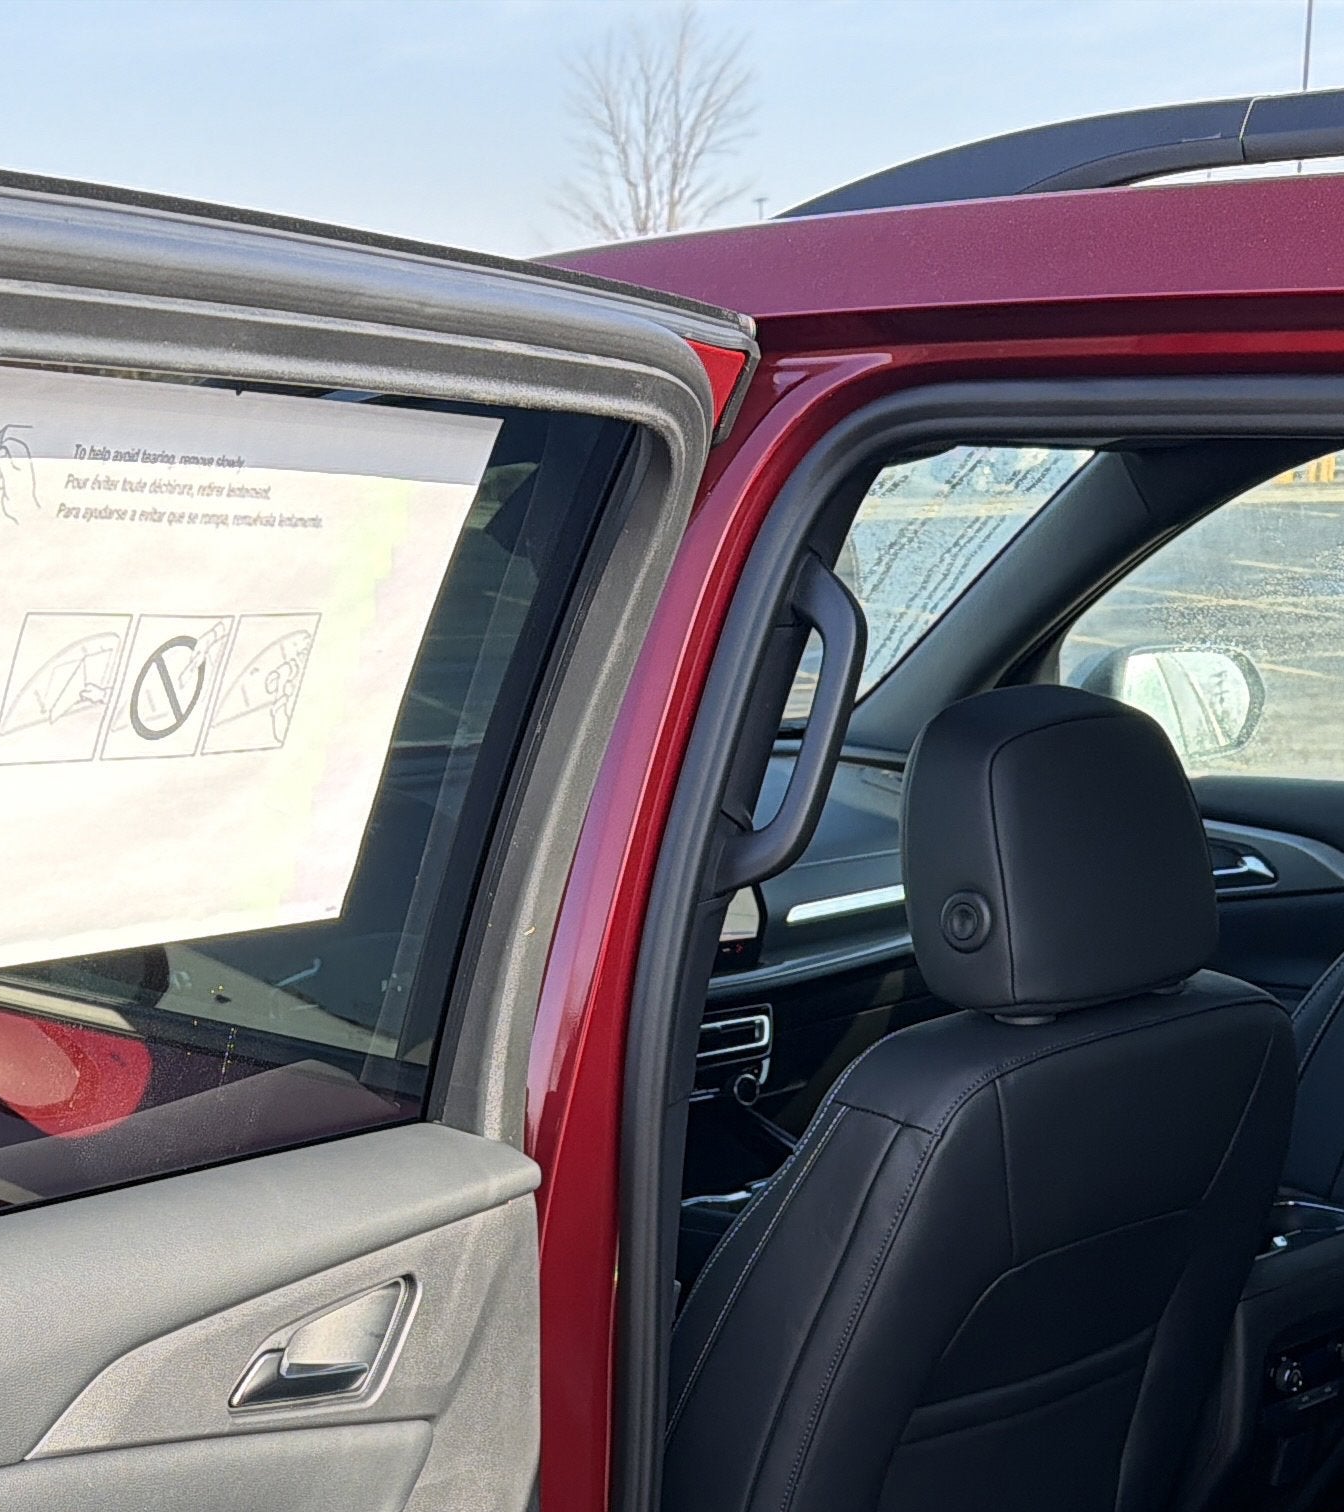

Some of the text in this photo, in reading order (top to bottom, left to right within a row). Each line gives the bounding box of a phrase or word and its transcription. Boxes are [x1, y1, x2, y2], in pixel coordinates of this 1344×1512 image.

[74, 443, 86, 460] To
[87, 445, 111, 463] help
[111, 447, 140, 462] avoid
[178, 455, 215, 466] remove
[64, 473, 90, 490] Pour
[91, 473, 120, 491] éviter
[121, 477, 147, 493] toute
[196, 481, 225, 497] retirer
[56, 502, 81, 519] Para
[82, 504, 128, 522] ayudarse
[129, 509, 137, 522] a
[138, 507, 166, 522] evitar
[167, 510, 186, 526] que
[187, 511, 199, 525] se
